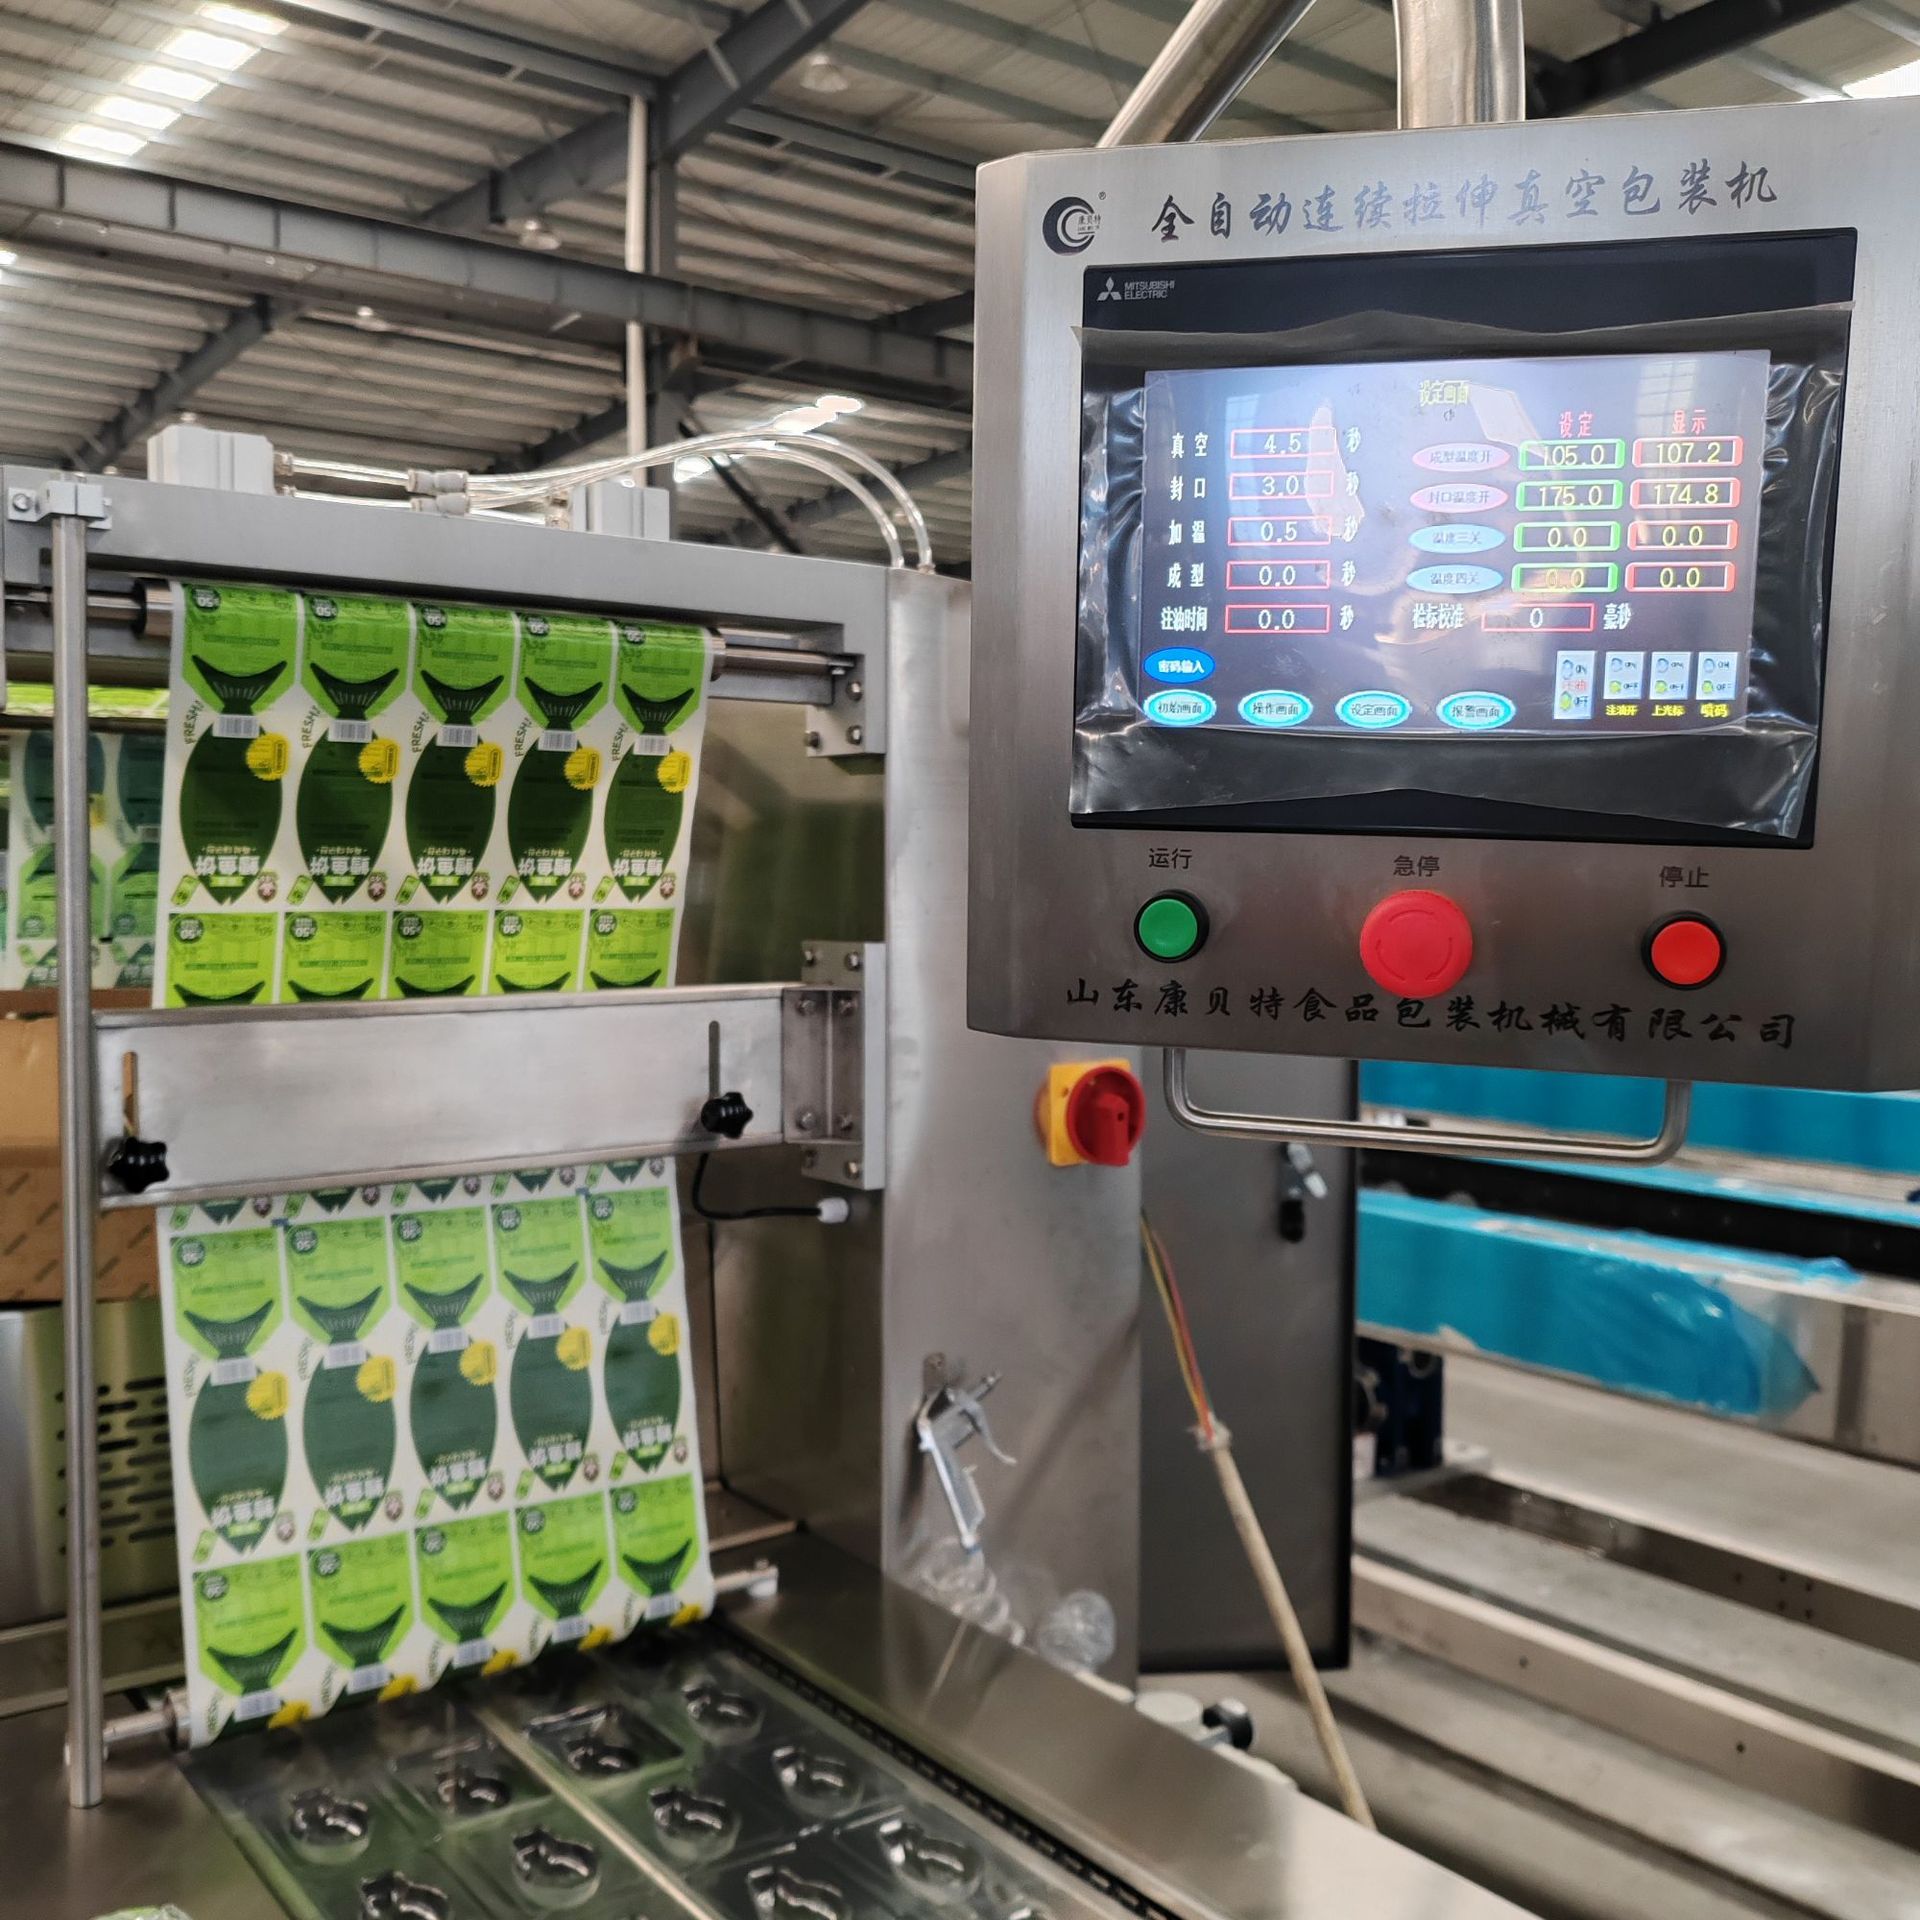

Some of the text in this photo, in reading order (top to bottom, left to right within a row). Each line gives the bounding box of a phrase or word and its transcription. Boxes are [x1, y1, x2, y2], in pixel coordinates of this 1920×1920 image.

[1151, 159, 1778, 242] 全自动连续拉伸真空包装机
[1124, 280, 1175, 290] MITSUBISHI
[1124, 290, 1168, 300] ELECTRIC
[1559, 409, 1707, 437] 设定 显示
[1170, 427, 1361, 459] 真空 4.5 秒
[1542, 444, 1605, 466] 105.0
[1656, 442, 1721, 464] 107.2
[1169, 471, 1360, 502] 封口 3.0 秒
[1538, 485, 1602, 507] 175.0
[1653, 483, 1719, 505] 174.8
[1168, 516, 1358, 546] 加温 0.5 秒
[1547, 526, 1587, 549] 0.0
[1661, 525, 1703, 547] 0.0
[1166, 561, 1356, 588] 成型 0.0 秒
[1545, 567, 1585, 589] 0.0
[1659, 566, 1700, 588] 0.0
[1161, 605, 1354, 632] 注油时间 0.0 秒
[1529, 608, 1544, 629] 0
[1603, 602, 1632, 630] 毫秒
[1158, 660, 1205, 675] 密码输入
[1157, 701, 1203, 715] 初始画面
[1252, 702, 1299, 716] 操作画面
[1350, 703, 1398, 717] 设定画面
[1148, 847, 1193, 870] 运行
[1394, 854, 1441, 878] 急停
[1658, 865, 1710, 890] 停止
[1066, 977, 1796, 1050] 山东康贝特食品包装机械有限公司
